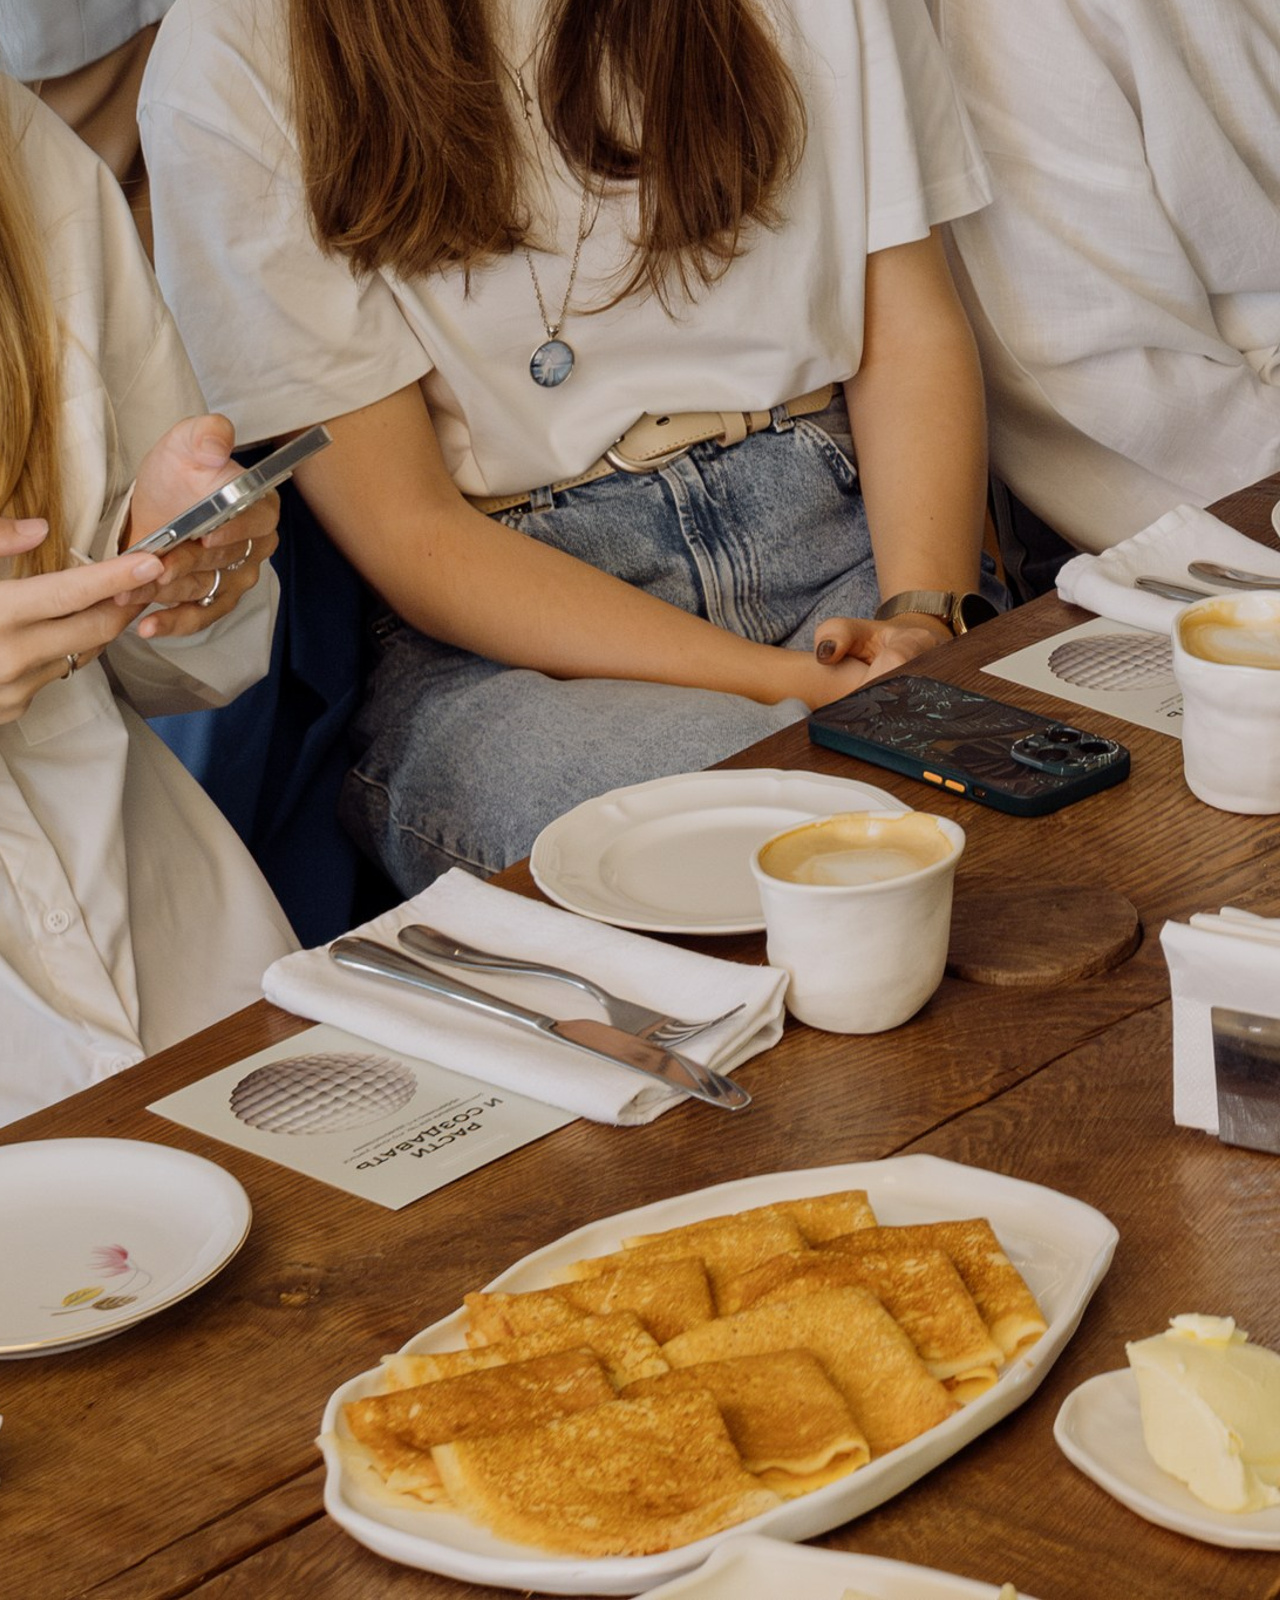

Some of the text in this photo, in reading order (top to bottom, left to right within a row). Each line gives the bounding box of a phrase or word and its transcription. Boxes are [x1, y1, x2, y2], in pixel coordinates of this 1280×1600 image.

[484, 1097, 504, 1108] И
[356, 1107, 484, 1170] СОЗДАВАТЬ
[410, 1122, 482, 1158] РАСТИ
